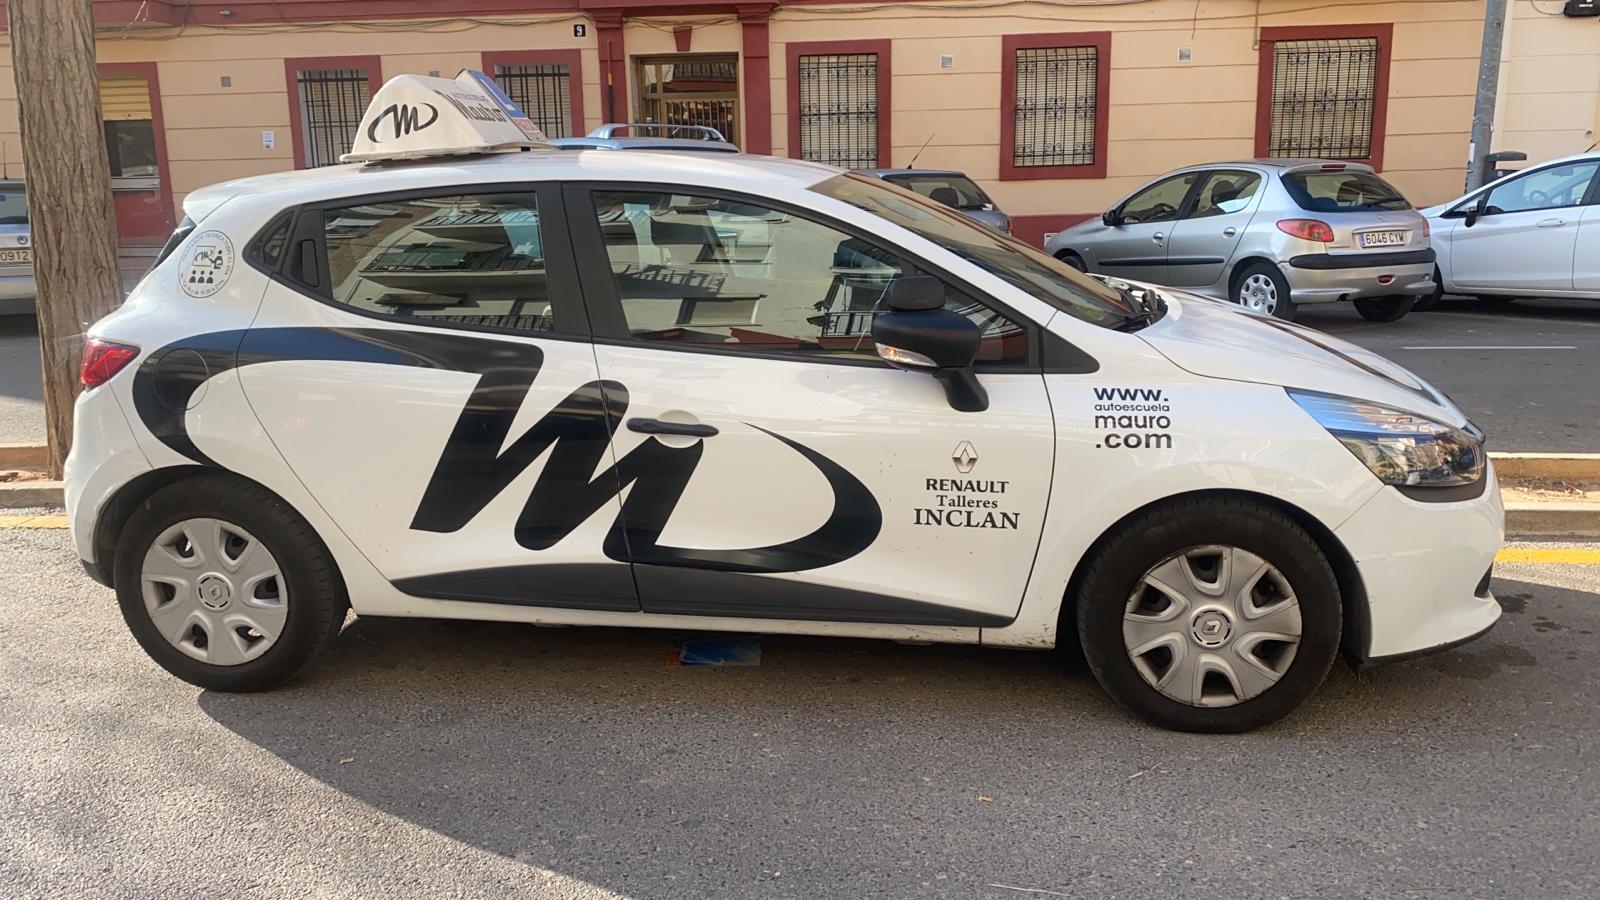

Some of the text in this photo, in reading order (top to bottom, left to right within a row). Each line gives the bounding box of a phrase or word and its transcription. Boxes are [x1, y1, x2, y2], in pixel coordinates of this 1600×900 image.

[576, 25, 584, 36] 9
[1365, 232, 1388, 245] 6046
[0, 251, 28, 261] 0912
[1093, 387, 1169, 402] www.
[1094, 402, 1170, 413] autoescuela
[1095, 414, 1171, 430] mauro
[1095, 432, 1172, 449] .com
[926, 478, 1010, 494] RENAULT
[936, 494, 998, 509] Talleres
[913, 508, 1021, 530] INCLAN
